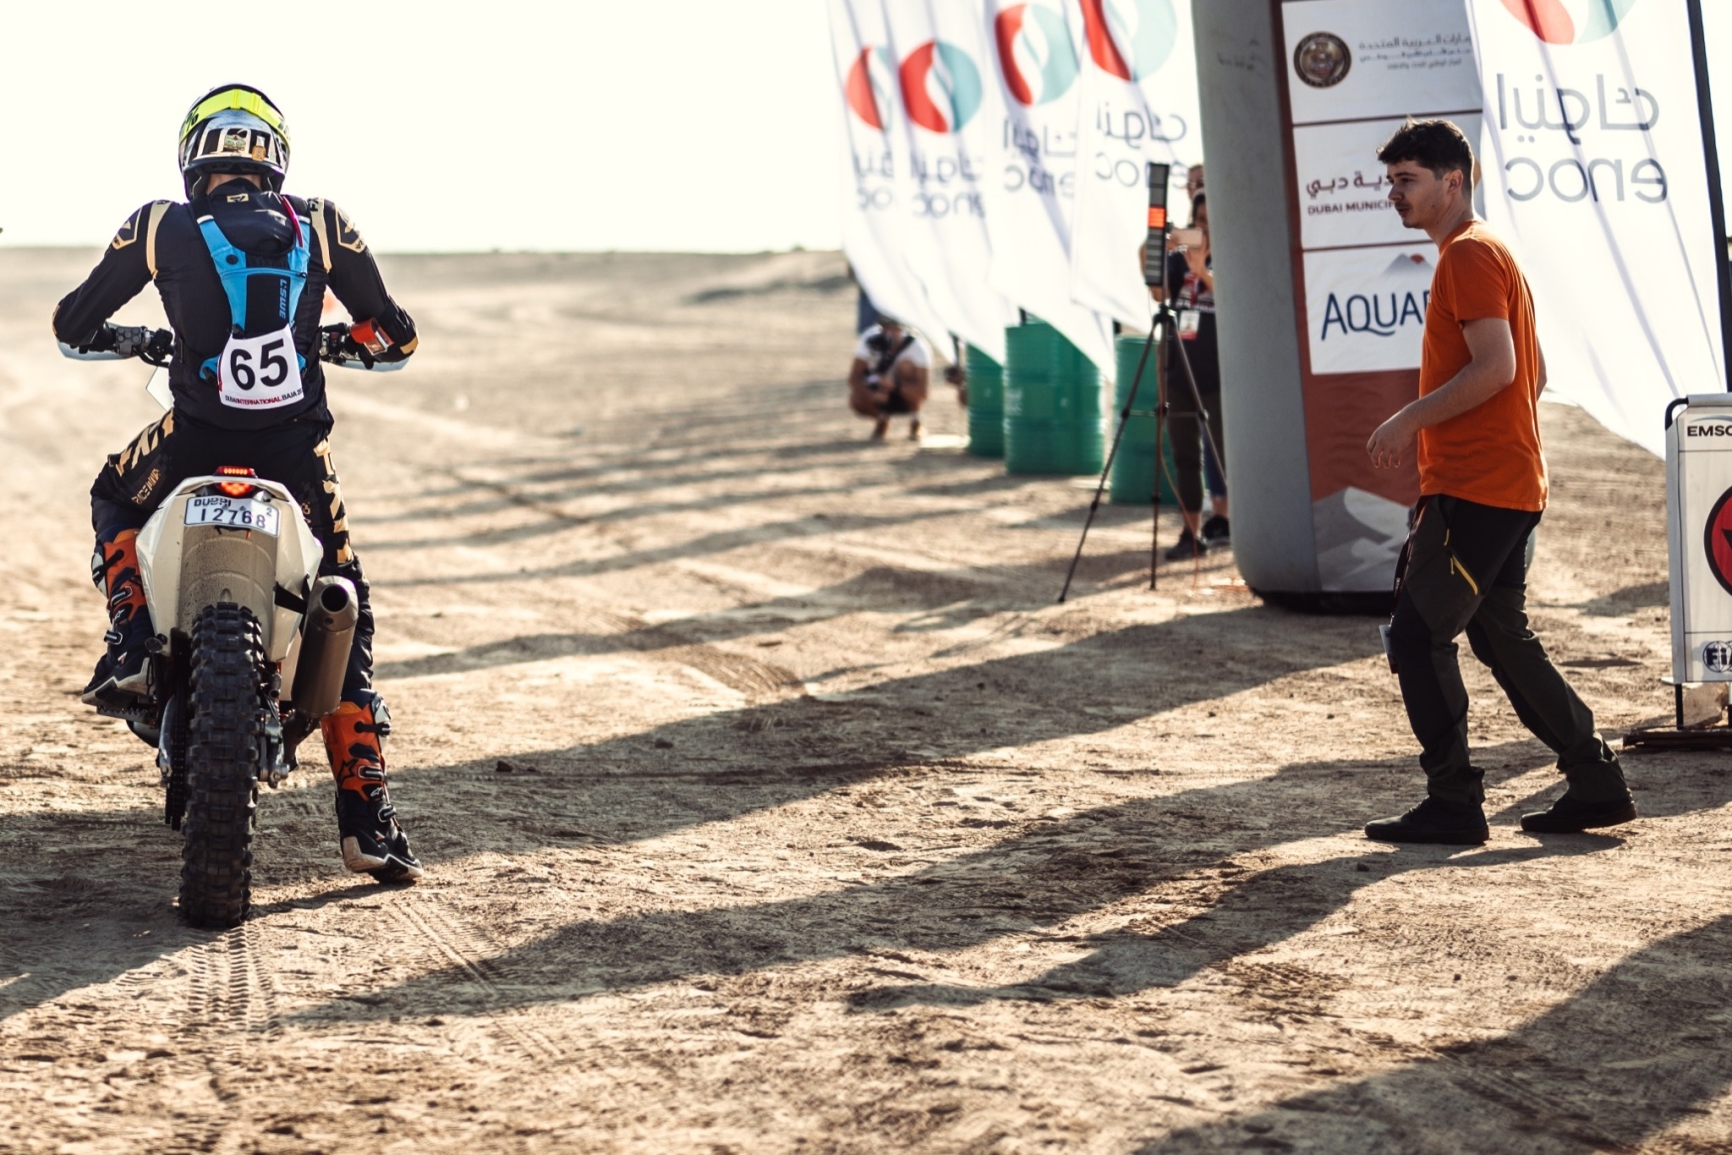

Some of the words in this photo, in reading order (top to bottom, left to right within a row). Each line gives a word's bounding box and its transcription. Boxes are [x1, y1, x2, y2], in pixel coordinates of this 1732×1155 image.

[1308, 203, 1342, 216] DUBAI
[1346, 200, 1394, 211] MUNICIP
[1321, 289, 1430, 341] AQUA
[230, 338, 288, 391] 65
[201, 508, 266, 528] 12768
